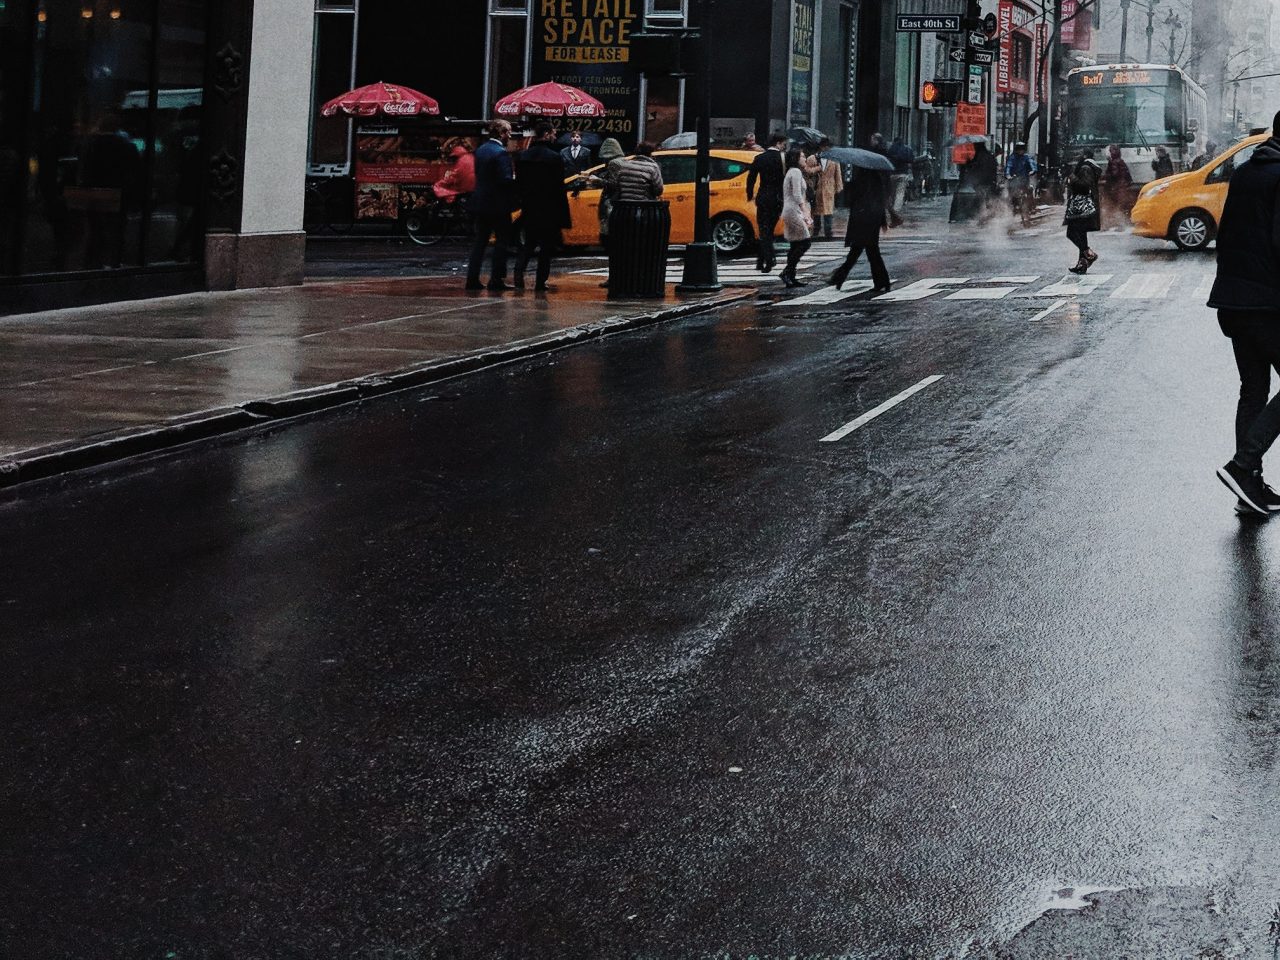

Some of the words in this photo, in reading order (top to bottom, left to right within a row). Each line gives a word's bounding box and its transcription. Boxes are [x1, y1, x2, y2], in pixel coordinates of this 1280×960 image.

[901, 19, 921, 28] East
[922, 19, 943, 28] 40th
[944, 19, 955, 28] St
[999, 6, 1011, 43] TRAVEL
[543, 18, 631, 44] SPACE
[552, 47, 577, 60] FOR
[581, 47, 622, 61] LEASE
[975, 53, 991, 62] WAY
[998, 46, 1010, 89] LIBERTY
[585, 75, 623, 85] CEILINGS
[588, 86, 631, 95] FRONTAGE
[551, 118, 633, 133] 2.372.2430
